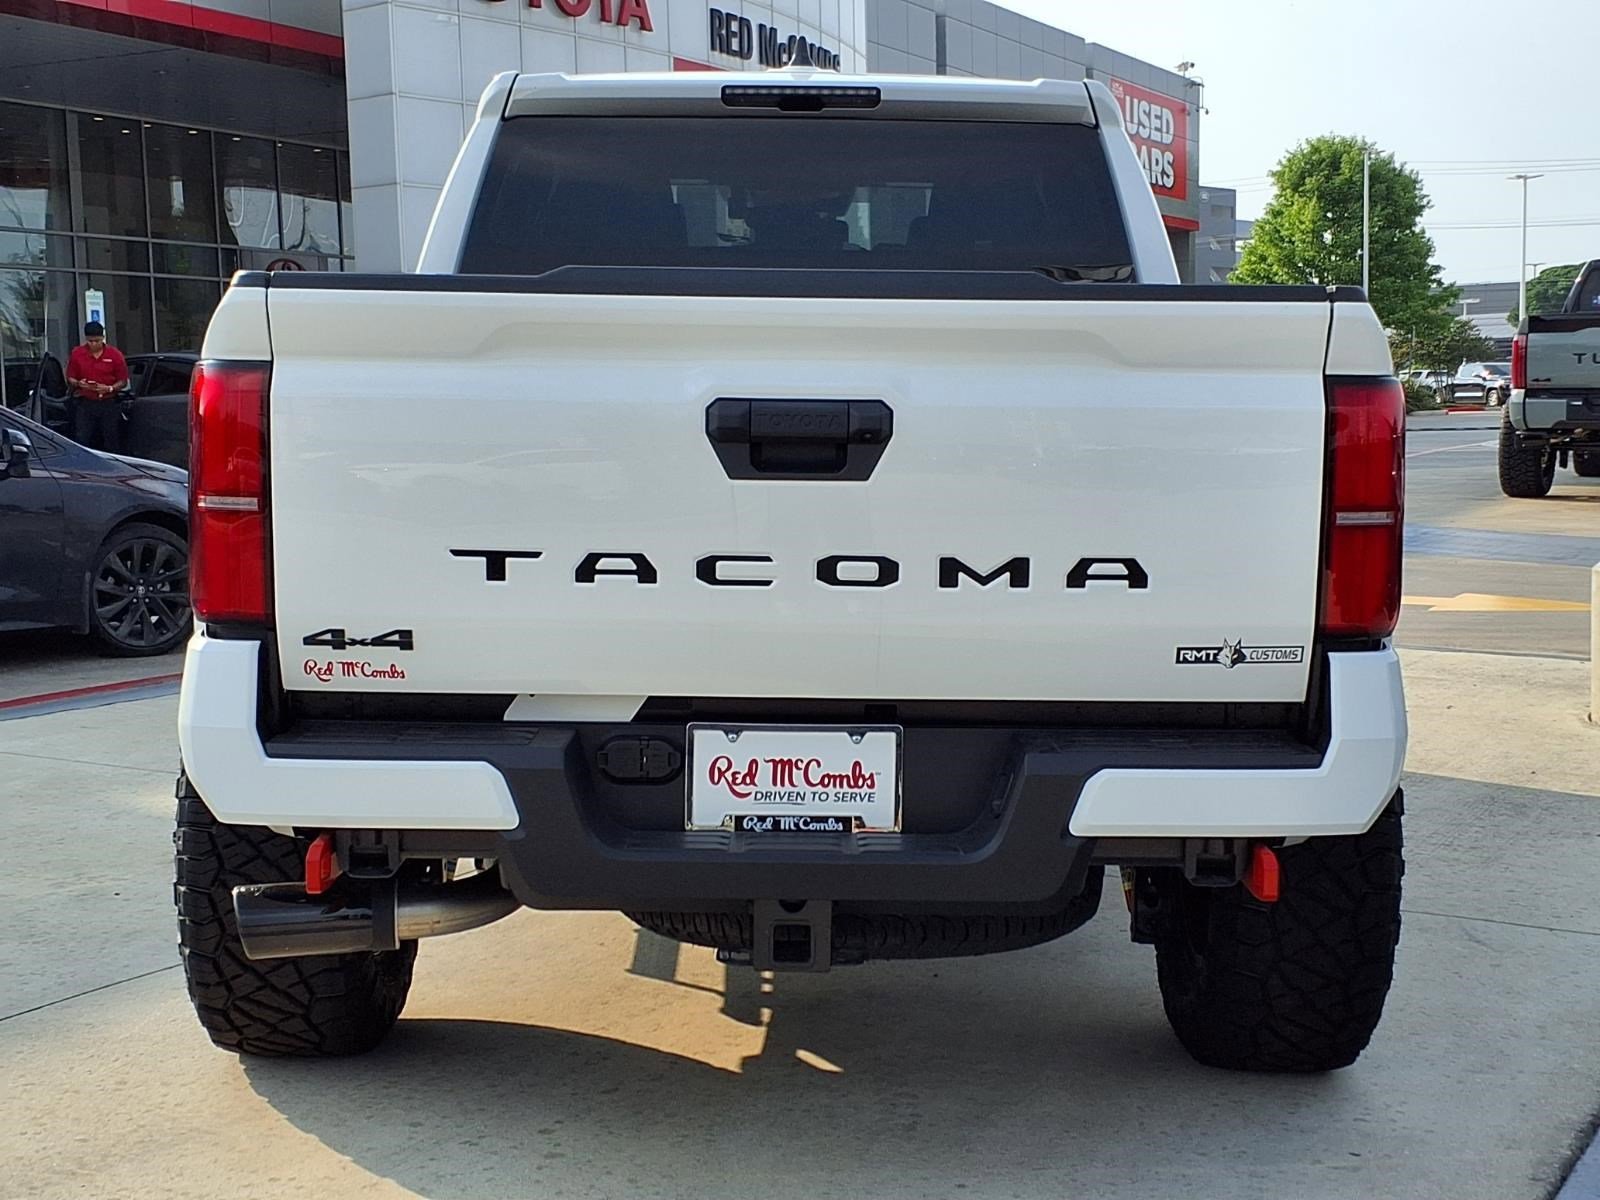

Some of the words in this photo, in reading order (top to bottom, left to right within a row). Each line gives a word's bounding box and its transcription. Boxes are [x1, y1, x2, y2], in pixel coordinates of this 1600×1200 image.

[709, 8, 753, 60] RED
[1125, 95, 1174, 145] USED
[1132, 142, 1174, 188] ARS
[755, 413, 842, 429] TOYOTA
[449, 549, 1149, 590] TACOMA
[302, 628, 414, 650] 4x4
[1179, 649, 1218, 662] RMT
[1249, 648, 1300, 661] CUSTOMS
[303, 658, 334, 682] Red
[336, 660, 406, 679] McCombs
[708, 755, 758, 799] Red
[763, 757, 876, 790] McCombs
[754, 791, 806, 802] DRIVEN
[811, 792, 829, 802] TO
[833, 791, 876, 803] SERVE
[743, 815, 773, 830] Red
[775, 816, 844, 831] McCombs
